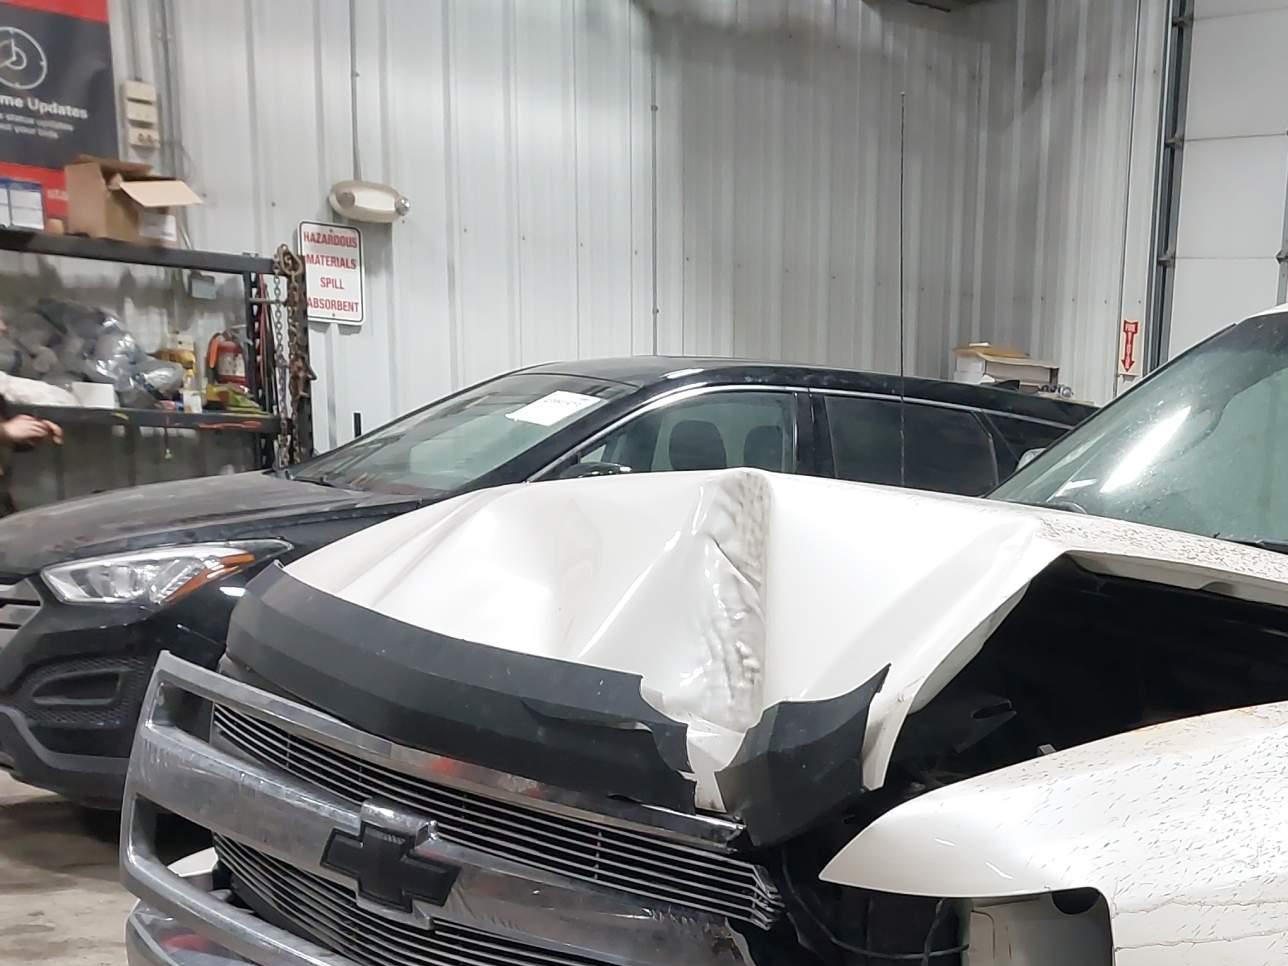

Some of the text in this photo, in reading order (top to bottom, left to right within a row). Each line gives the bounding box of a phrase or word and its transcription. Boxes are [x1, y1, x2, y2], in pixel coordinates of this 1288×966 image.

[27, 97, 88, 119] Updates
[304, 231, 357, 249] HAZARDOUS
[306, 254, 357, 270] MATERIALS
[320, 277, 344, 290] SPILL
[308, 297, 359, 312] ABSORBENT
